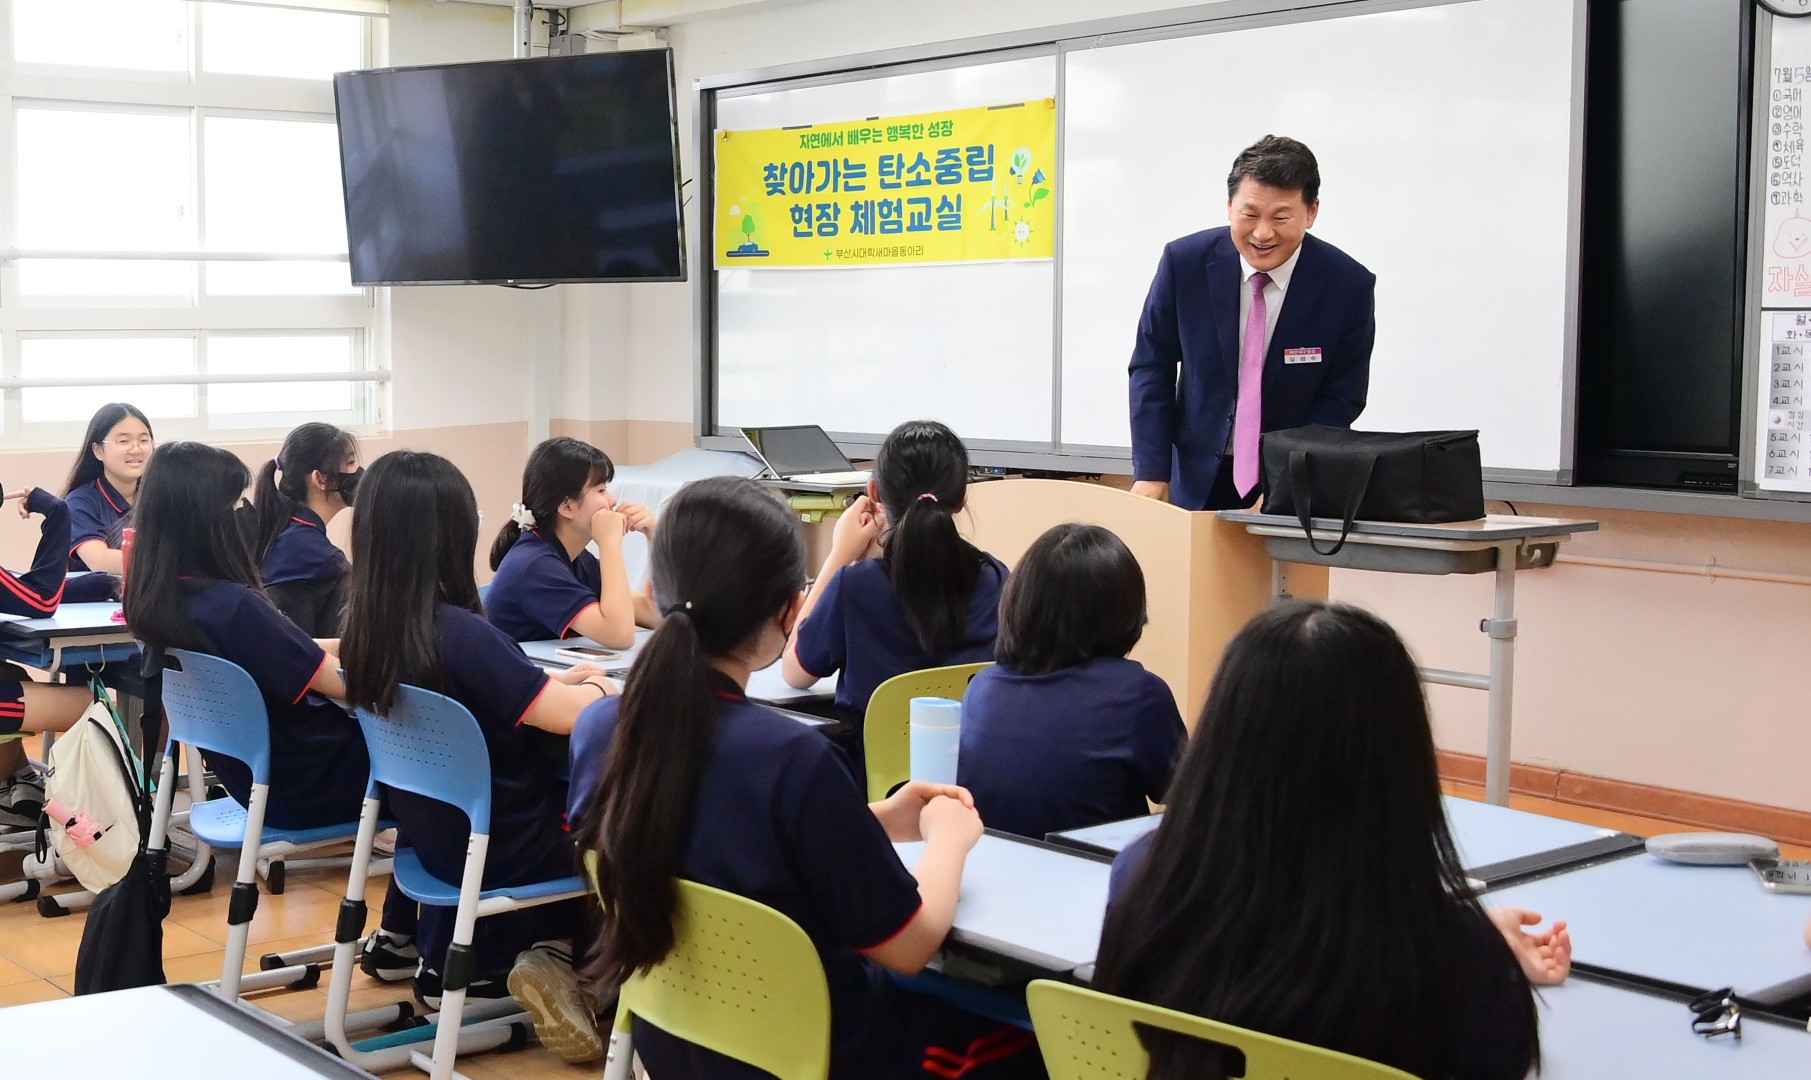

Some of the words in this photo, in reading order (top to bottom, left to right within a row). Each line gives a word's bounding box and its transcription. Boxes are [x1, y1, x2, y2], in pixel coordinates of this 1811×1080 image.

[800, 131, 844, 149] 자연에서
[847, 127, 883, 145] 배우는
[886, 123, 925, 142] 행복한
[928, 120, 954, 138] 성장
[763, 157, 867, 197] 찾아가는
[878, 143, 994, 190] 탄소중립
[789, 201, 841, 238] 현장
[850, 193, 962, 235] 체험교실
